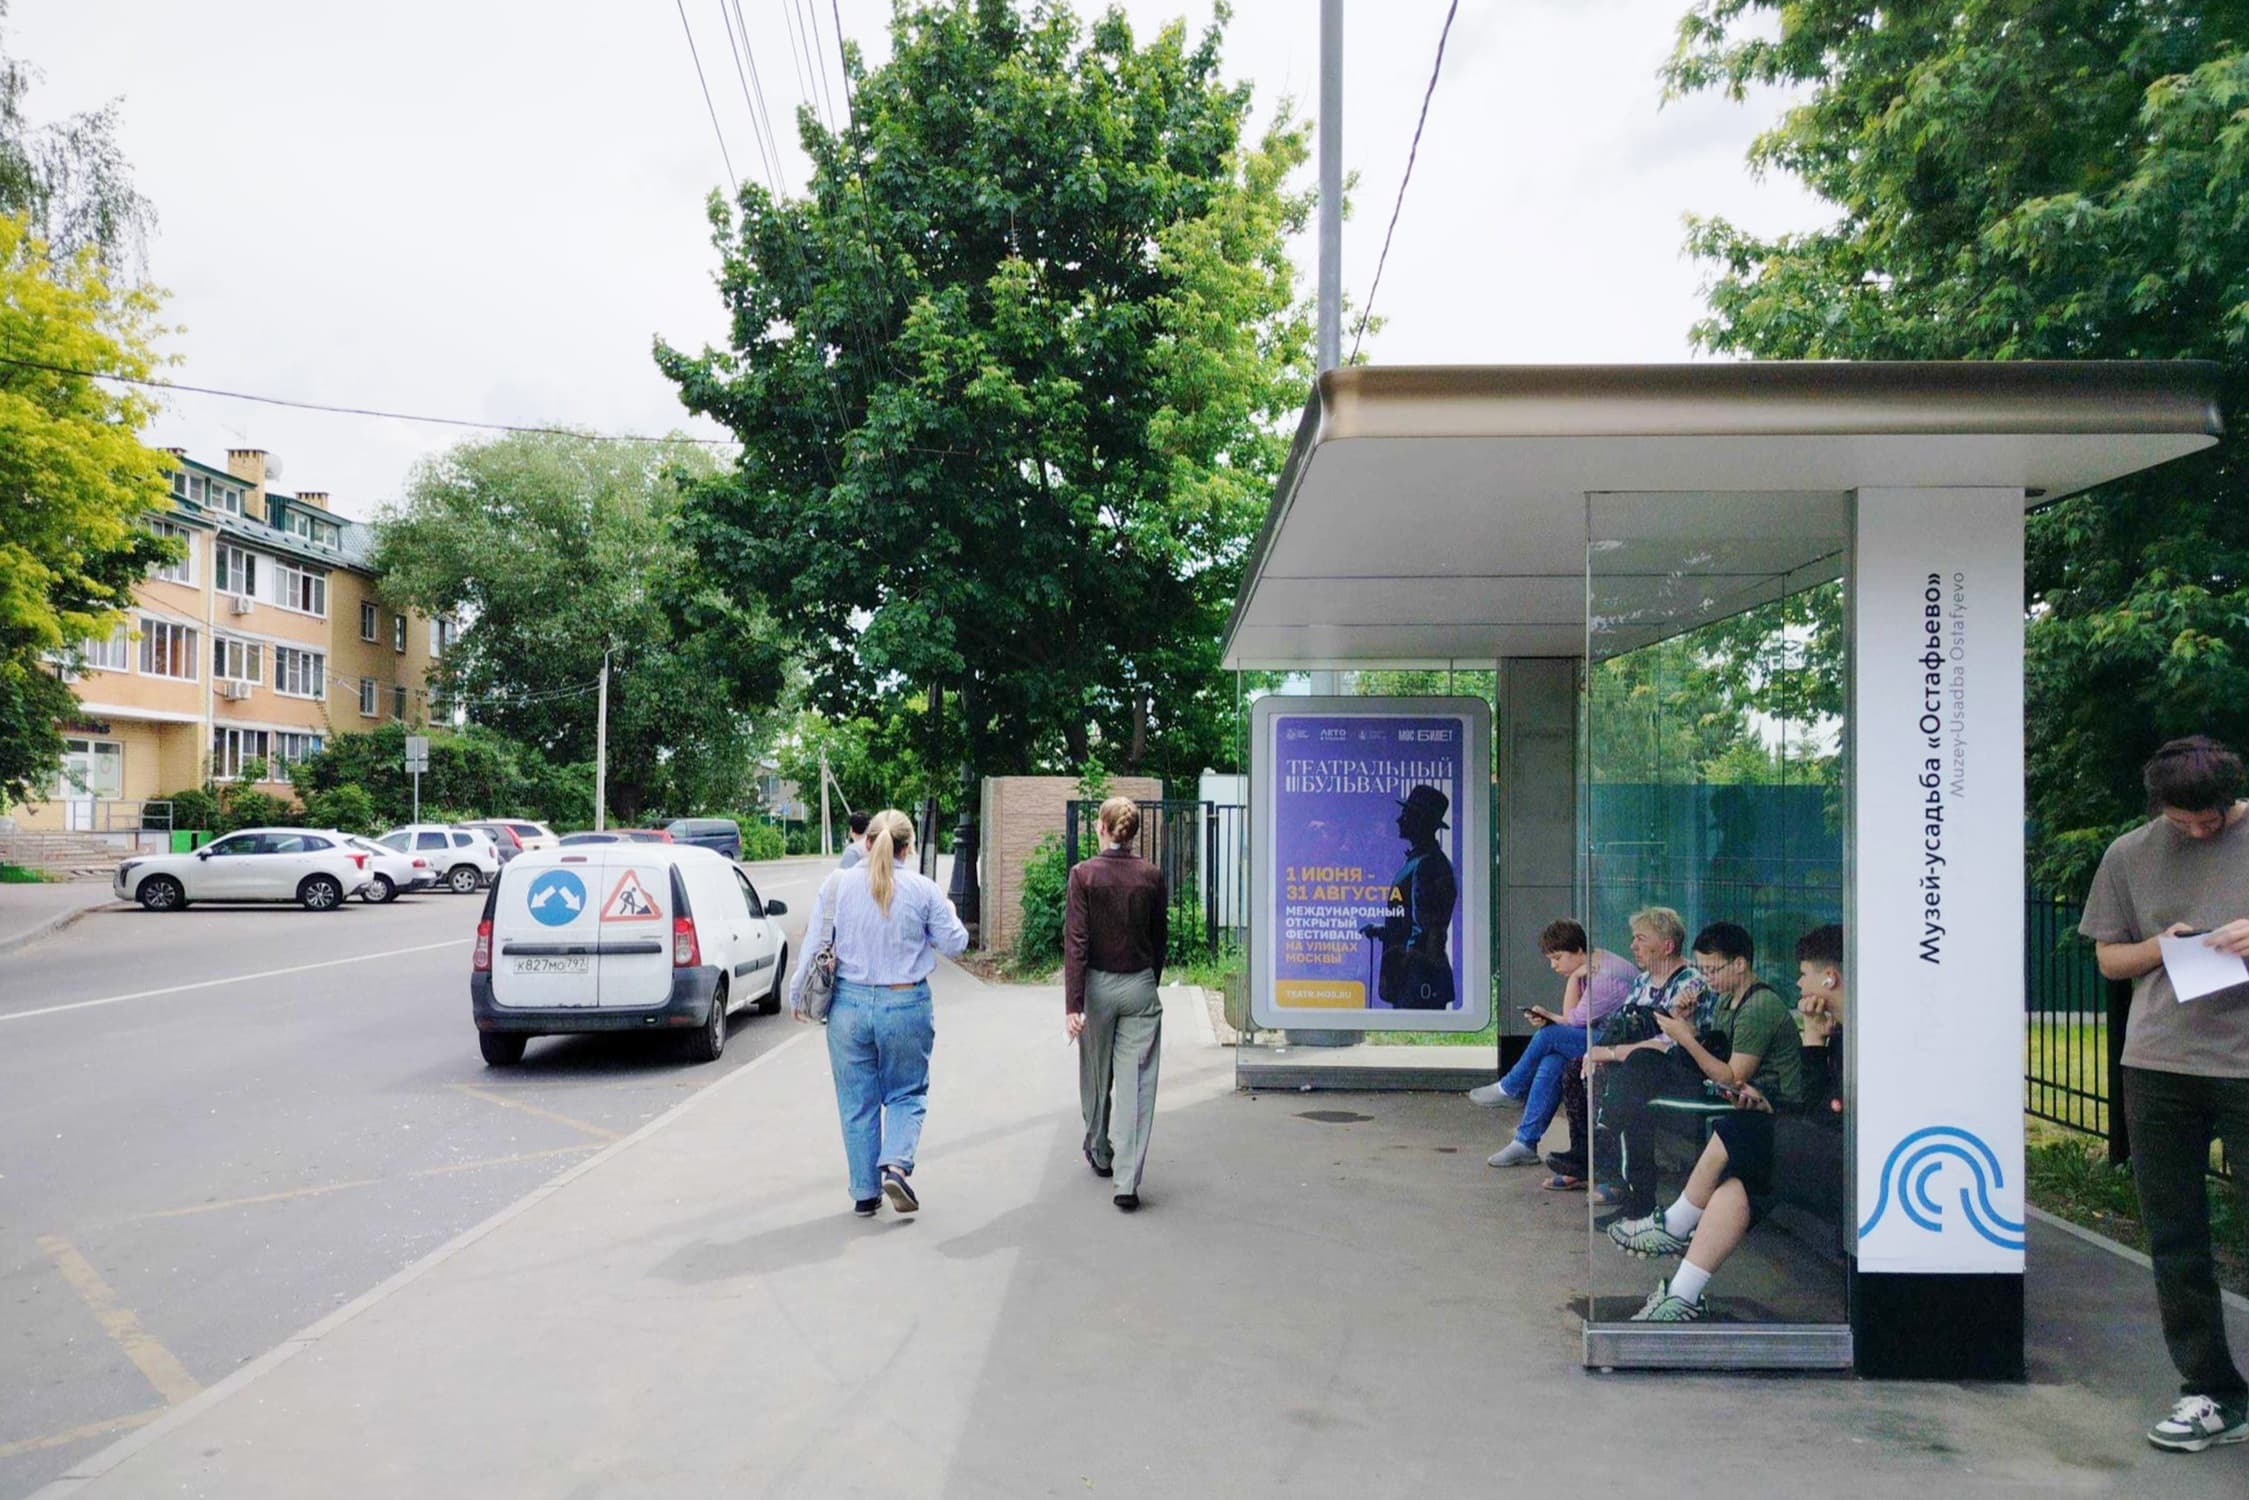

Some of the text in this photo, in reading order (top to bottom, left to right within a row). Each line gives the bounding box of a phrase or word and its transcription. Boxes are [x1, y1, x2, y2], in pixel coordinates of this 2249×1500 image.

[1949, 572, 1968, 798] Muzey-Usadba Ostafyevo
[1286, 757, 1453, 777] ТЕАТРАЛЬНЫЙ
[1918, 573, 1946, 964] Музей-усадьба «Остафьево»
[1302, 776, 1399, 793] БУЛЬВАР
[1286, 867, 1296, 882] 1
[1301, 867, 1363, 882] ИЮНЯ
[1286, 885, 1404, 902] 31 АВГУСТА
[1286, 905, 1405, 918] МЕЖДУНАРОДНЫЙ
[1286, 916, 1358, 928] ОТКРЫТЫЙ
[1285, 929, 1363, 941] ФЕСТИВАЛЬ
[1286, 941, 1358, 953] НА УЛИЦАХ
[1286, 953, 1343, 965] МОСКВЫ
